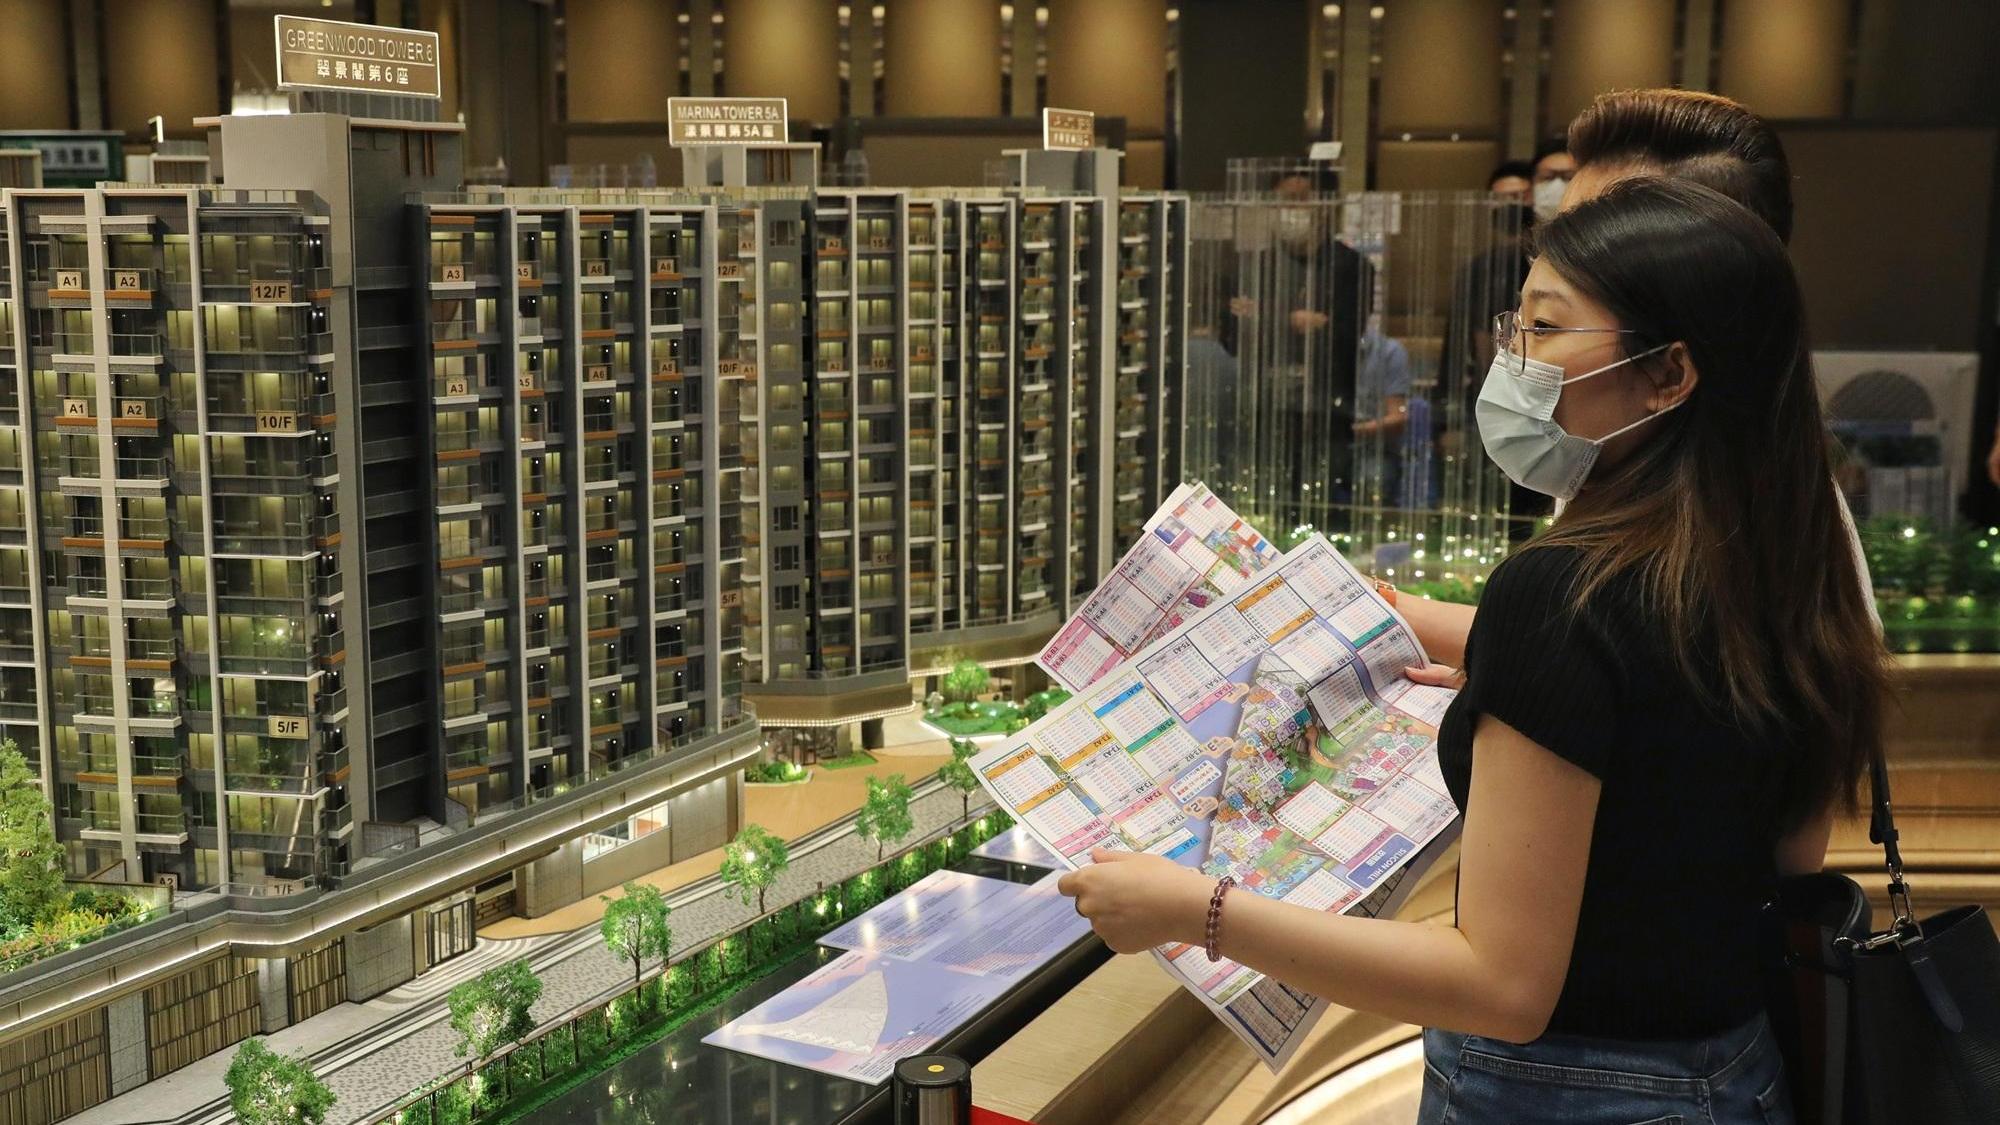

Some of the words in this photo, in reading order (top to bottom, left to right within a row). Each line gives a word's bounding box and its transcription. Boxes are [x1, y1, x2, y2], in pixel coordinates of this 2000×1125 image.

[286, 28, 375, 56] GREENWOOD
[379, 38, 424, 62] TOWER
[426, 44, 433, 62] 6
[677, 105, 721, 119] MARINA
[721, 105, 764, 120] TOWER
[764, 105, 779, 119] 5A
[63, 276, 78, 287] A1
[119, 276, 136, 287] A2
[446, 270, 460, 279] A3
[254, 285, 287, 299] 12/F
[450, 383, 464, 393] A3
[69, 403, 84, 414] A1
[126, 404, 142, 416] A2
[260, 415, 293, 430] 10/F
[1172, 640, 1189, 654] T5-A3
[277, 721, 300, 734] 5/F
[1016, 748, 1033, 762] T2-A2
[1102, 744, 1120, 758] T3-A3
[1135, 780, 1152, 794] T3-A3
[1191, 803, 1201, 812] 2
[1381, 848, 1407, 870] SILICON
[1368, 866, 1384, 880] HILL
